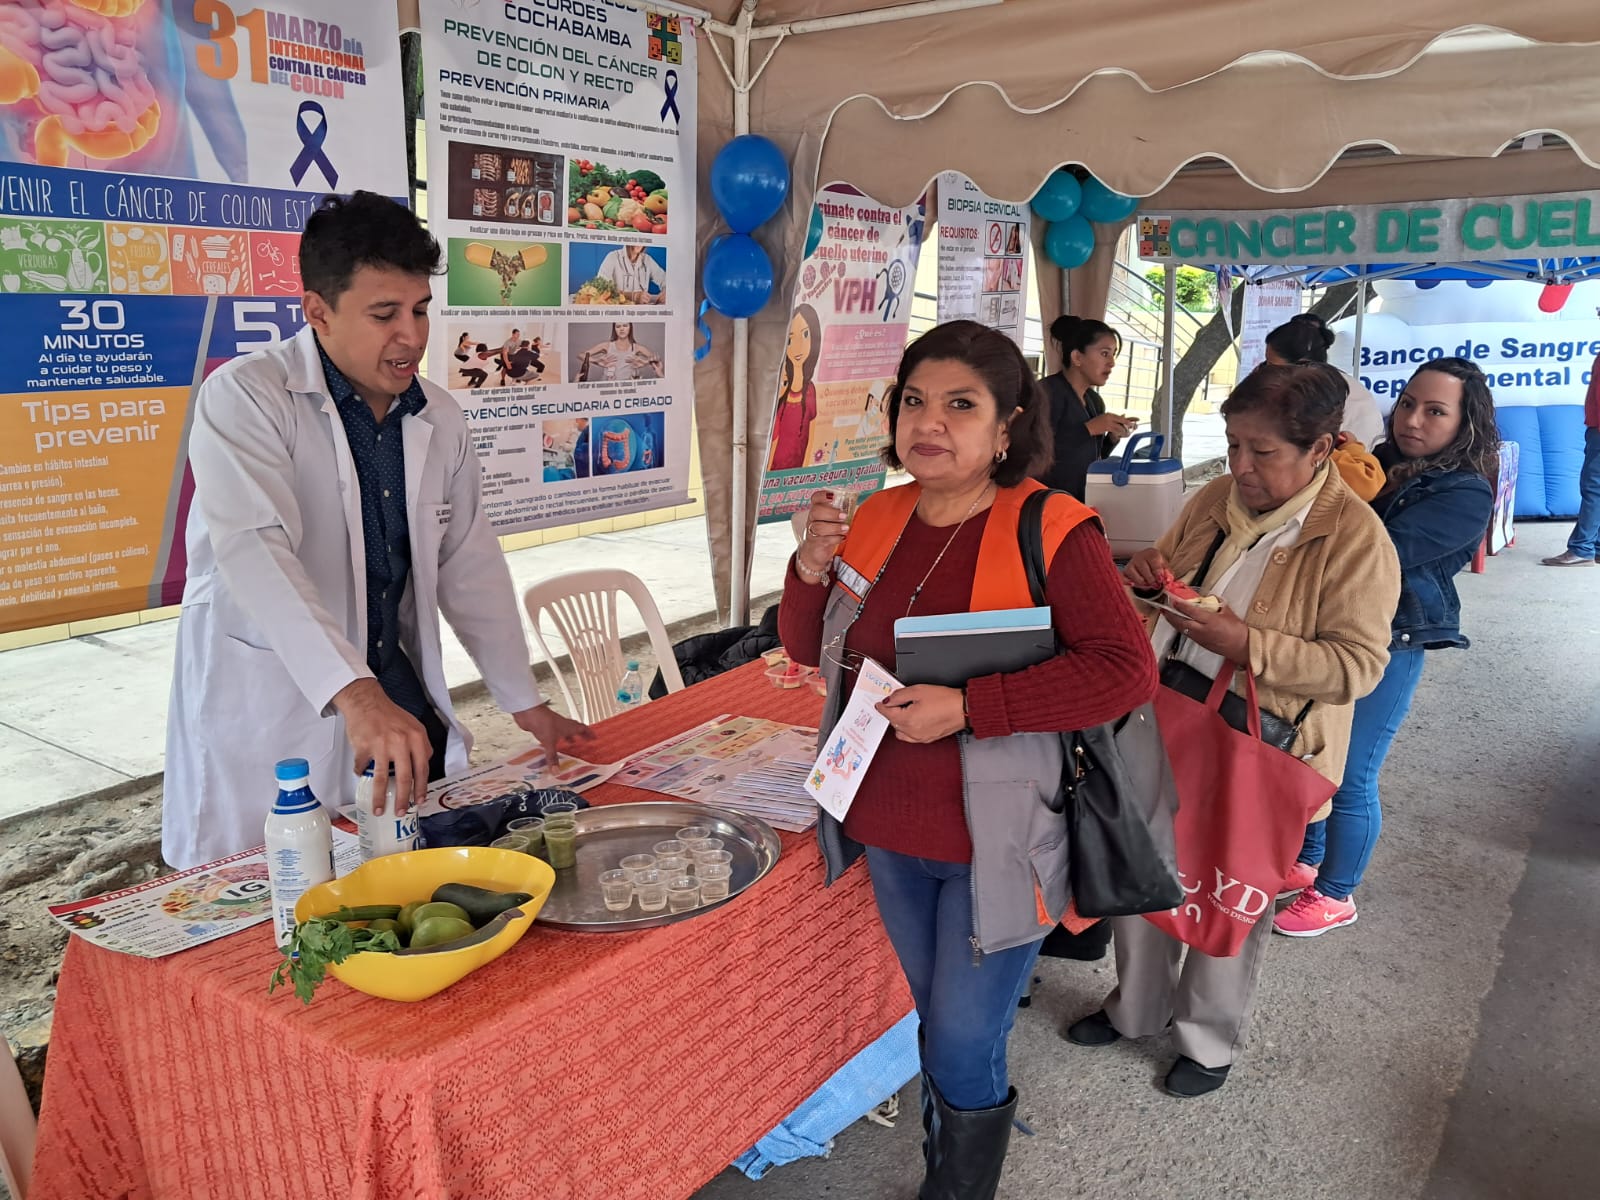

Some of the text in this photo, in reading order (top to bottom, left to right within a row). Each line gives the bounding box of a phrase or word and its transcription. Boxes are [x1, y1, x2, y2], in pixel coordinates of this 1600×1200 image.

[504, 3, 632, 49] COCHABAMBA
[193, 0, 364, 84] 31 MARZO DÍA
[268, 39, 366, 71] INTERNACIONAL
[444, 18, 658, 80] PREVENCIÓN DEL CÁNCER
[269, 56, 367, 85] CONTRA EL CÁNCER
[477, 50, 634, 94] DE COLON Y RECTO
[270, 70, 345, 99] DEL COLON
[439, 69, 611, 111] PREVENCIÓN PRIMARIA
[70, 180, 90, 215] EL
[104, 178, 175, 220] CÁNCER
[189, 191, 208, 223] DE
[221, 194, 272, 227] COLON
[857, 206, 891, 224] contra
[893, 210, 902, 225] el
[947, 198, 1021, 217] BIOPSIA CERVICAL
[827, 222, 880, 243] cáncer de
[1169, 210, 1357, 259] CANCER
[1375, 207, 1442, 254] DE
[18, 254, 58, 269] VERDURAS
[130, 245, 156, 257] FRUTAS
[850, 245, 888, 264] uterino
[202, 261, 231, 274] CEREALES
[833, 277, 878, 315] VPH
[59, 300, 126, 331] 30
[233, 301, 282, 354] 5
[43, 334, 145, 350] MINUTOS
[1360, 337, 1600, 367] Banco de Sangre
[39, 352, 153, 364] Al día te ayudarán
[40, 364, 153, 376] a cuidar tu peso y
[27, 374, 167, 388] mantenerte saludable.
[22, 399, 166, 425] Tips para
[531, 399, 610, 416] SECUNDARIA
[614, 399, 622, 409] O
[624, 395, 673, 408] CRIBADO
[35, 420, 160, 454] prevenir
[34, 463, 43, 471] en
[75, 456, 109, 468] intestinal
[783, 473, 816, 486] vacuna
[818, 468, 848, 483] segura
[848, 468, 854, 481] y
[35, 494, 45, 505] de
[47, 493, 73, 505] sangre
[75, 491, 84, 500] en
[85, 489, 97, 499] las
[101, 866, 202, 901] TRATAMIENTO
[226, 881, 266, 898] IG
[1212, 866, 1269, 916] YD
